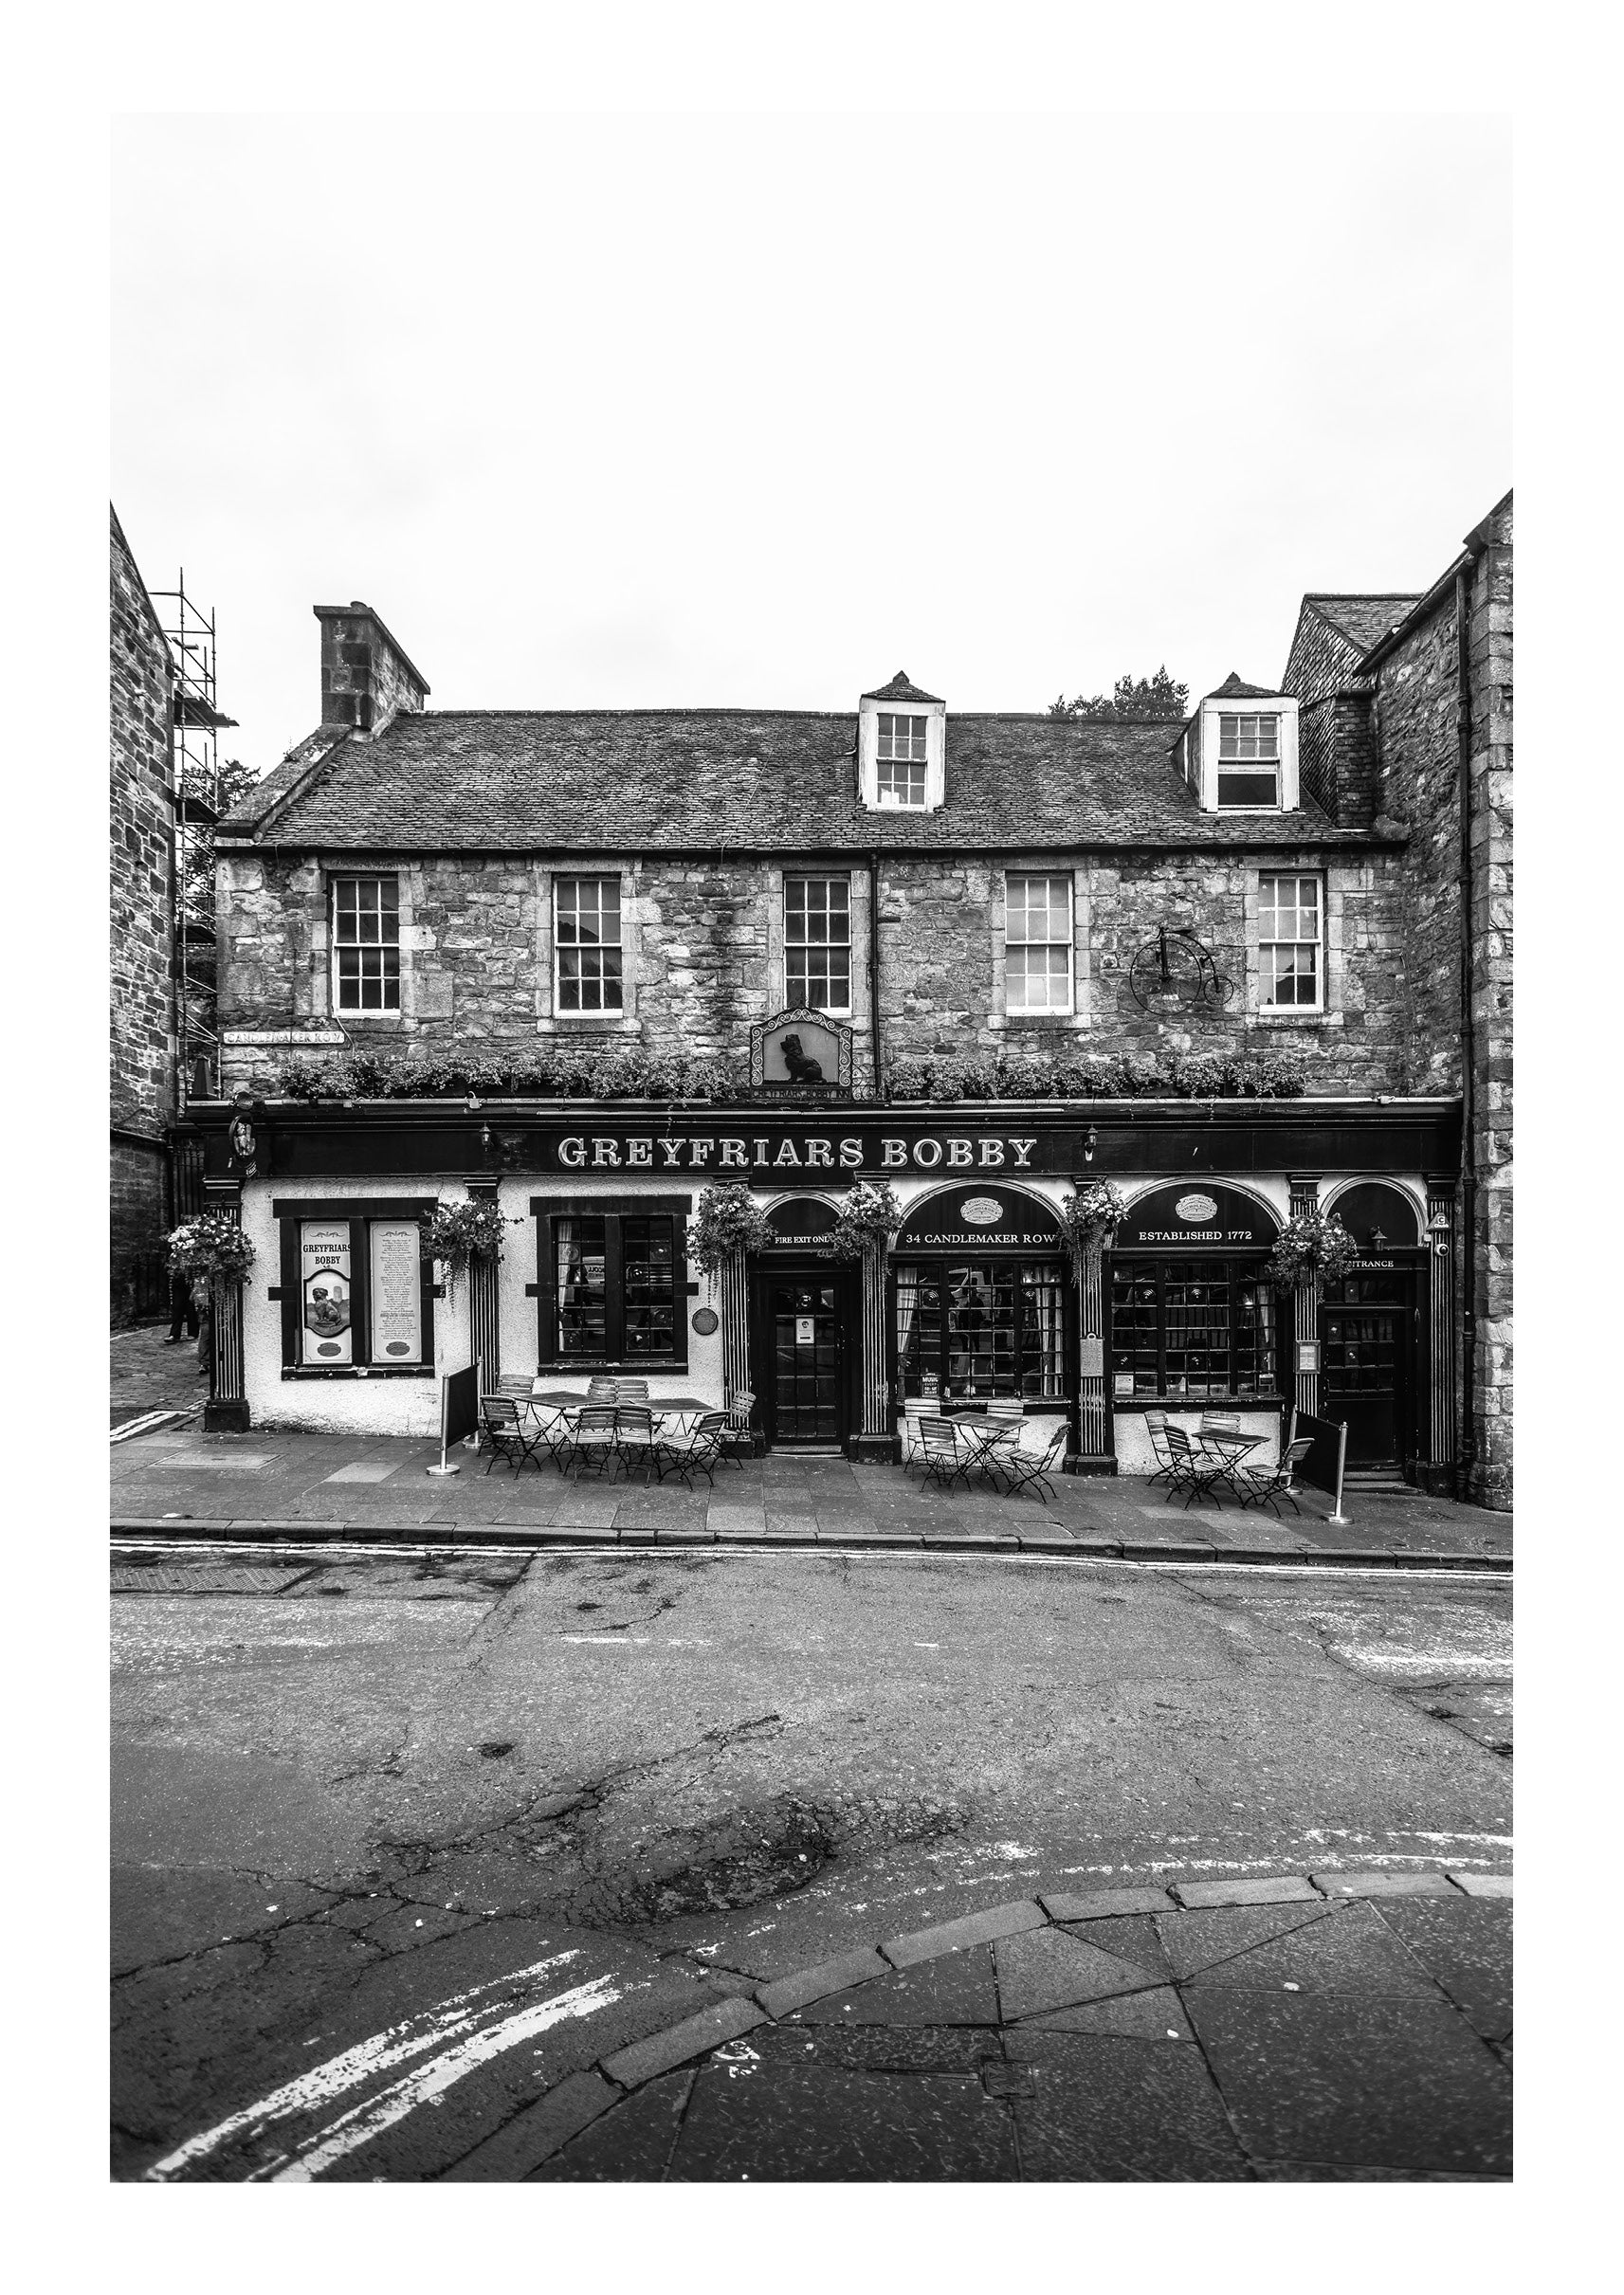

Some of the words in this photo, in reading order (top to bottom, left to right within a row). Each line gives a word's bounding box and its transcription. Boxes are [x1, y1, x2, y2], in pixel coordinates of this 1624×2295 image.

[558, 1138, 864, 1167] GREYFRIARS
[882, 1138, 1037, 1167] BOBBY
[905, 1234, 921, 1243] 34
[924, 1234, 1019, 1244] CANDLEMAKER
[1023, 1234, 1055, 1244] ROW
[1139, 1231, 1223, 1240] ESTABLISHED
[1227, 1231, 1252, 1240] 1772
[315, 1256, 341, 1265] BOBBY
